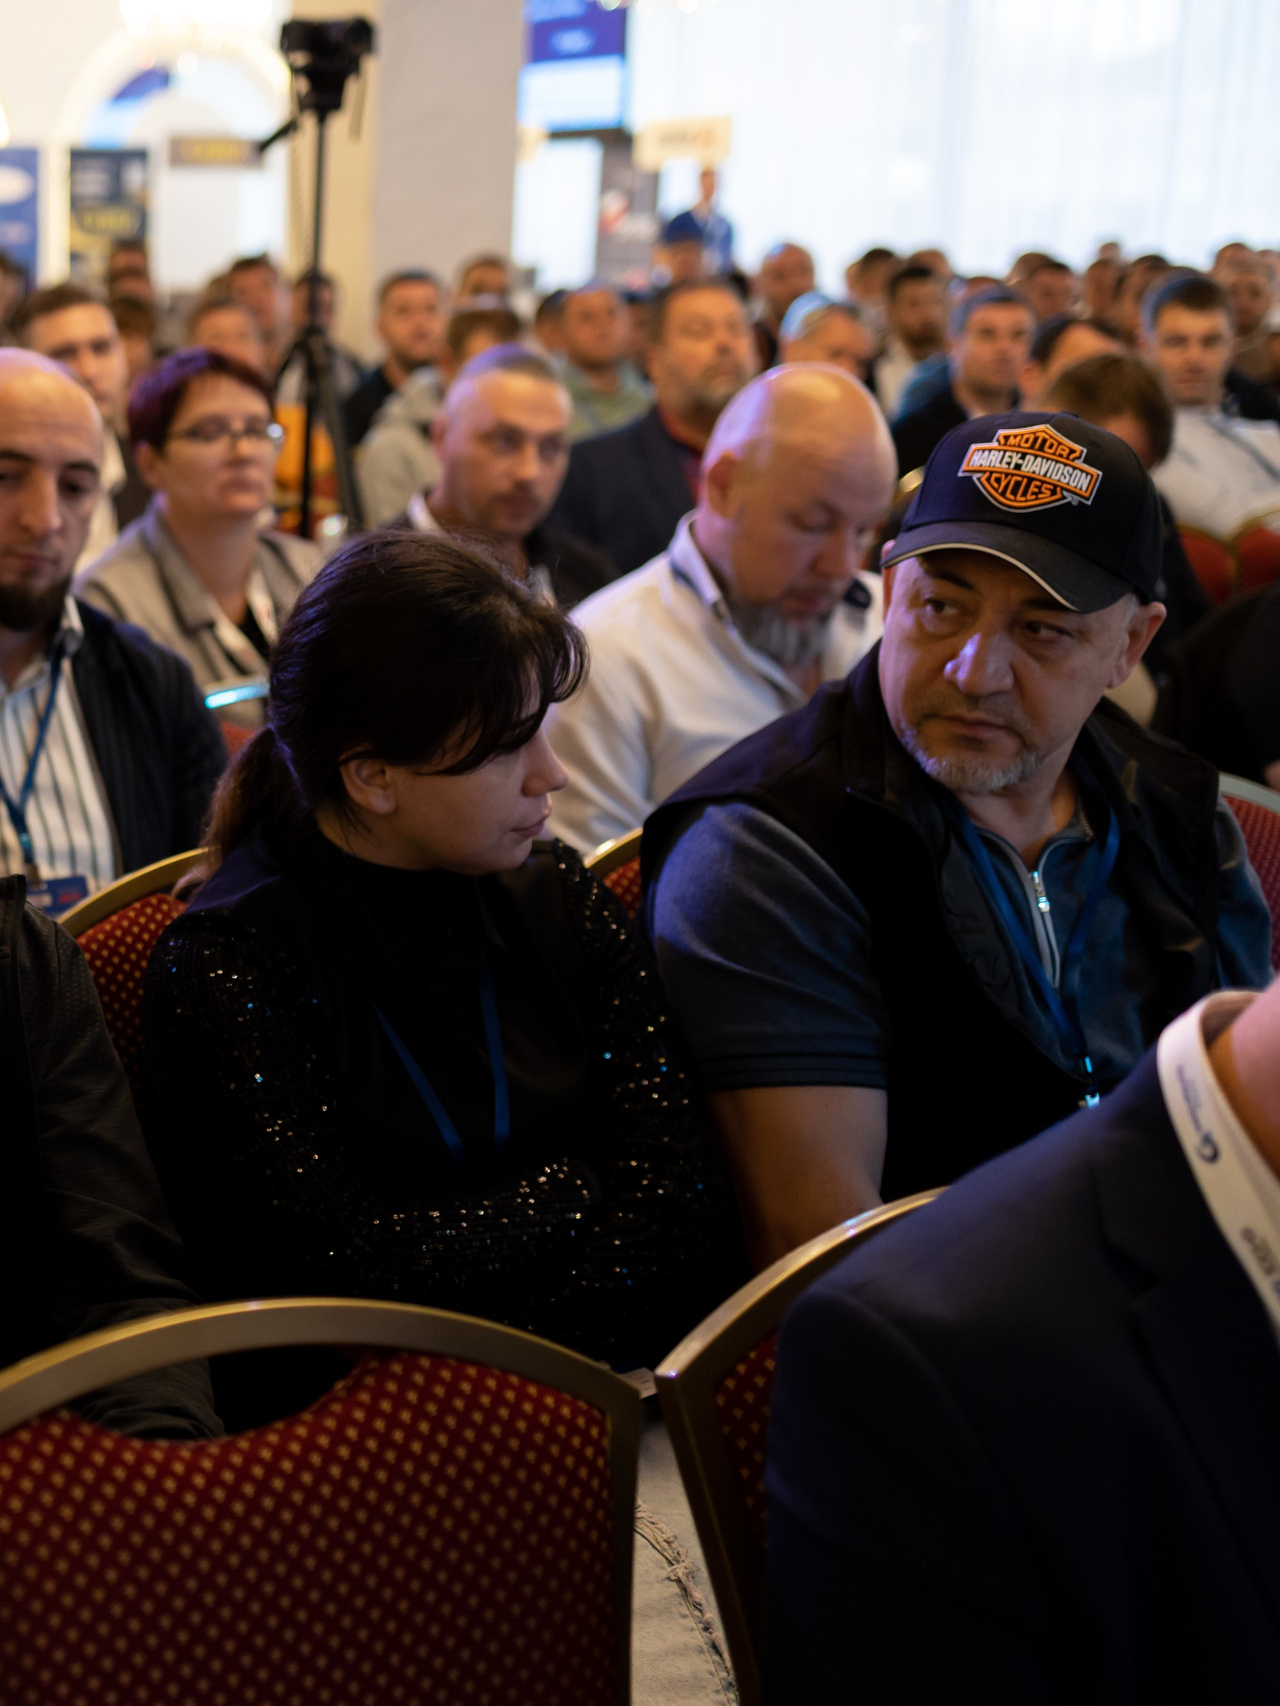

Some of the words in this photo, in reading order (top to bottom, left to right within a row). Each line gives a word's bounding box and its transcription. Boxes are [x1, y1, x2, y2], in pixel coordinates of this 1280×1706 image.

[1006, 432, 1070, 459] MOTOR
[968, 449, 1092, 492] HARLEY-DAVIDSON
[990, 472, 1054, 501] CYCLES
